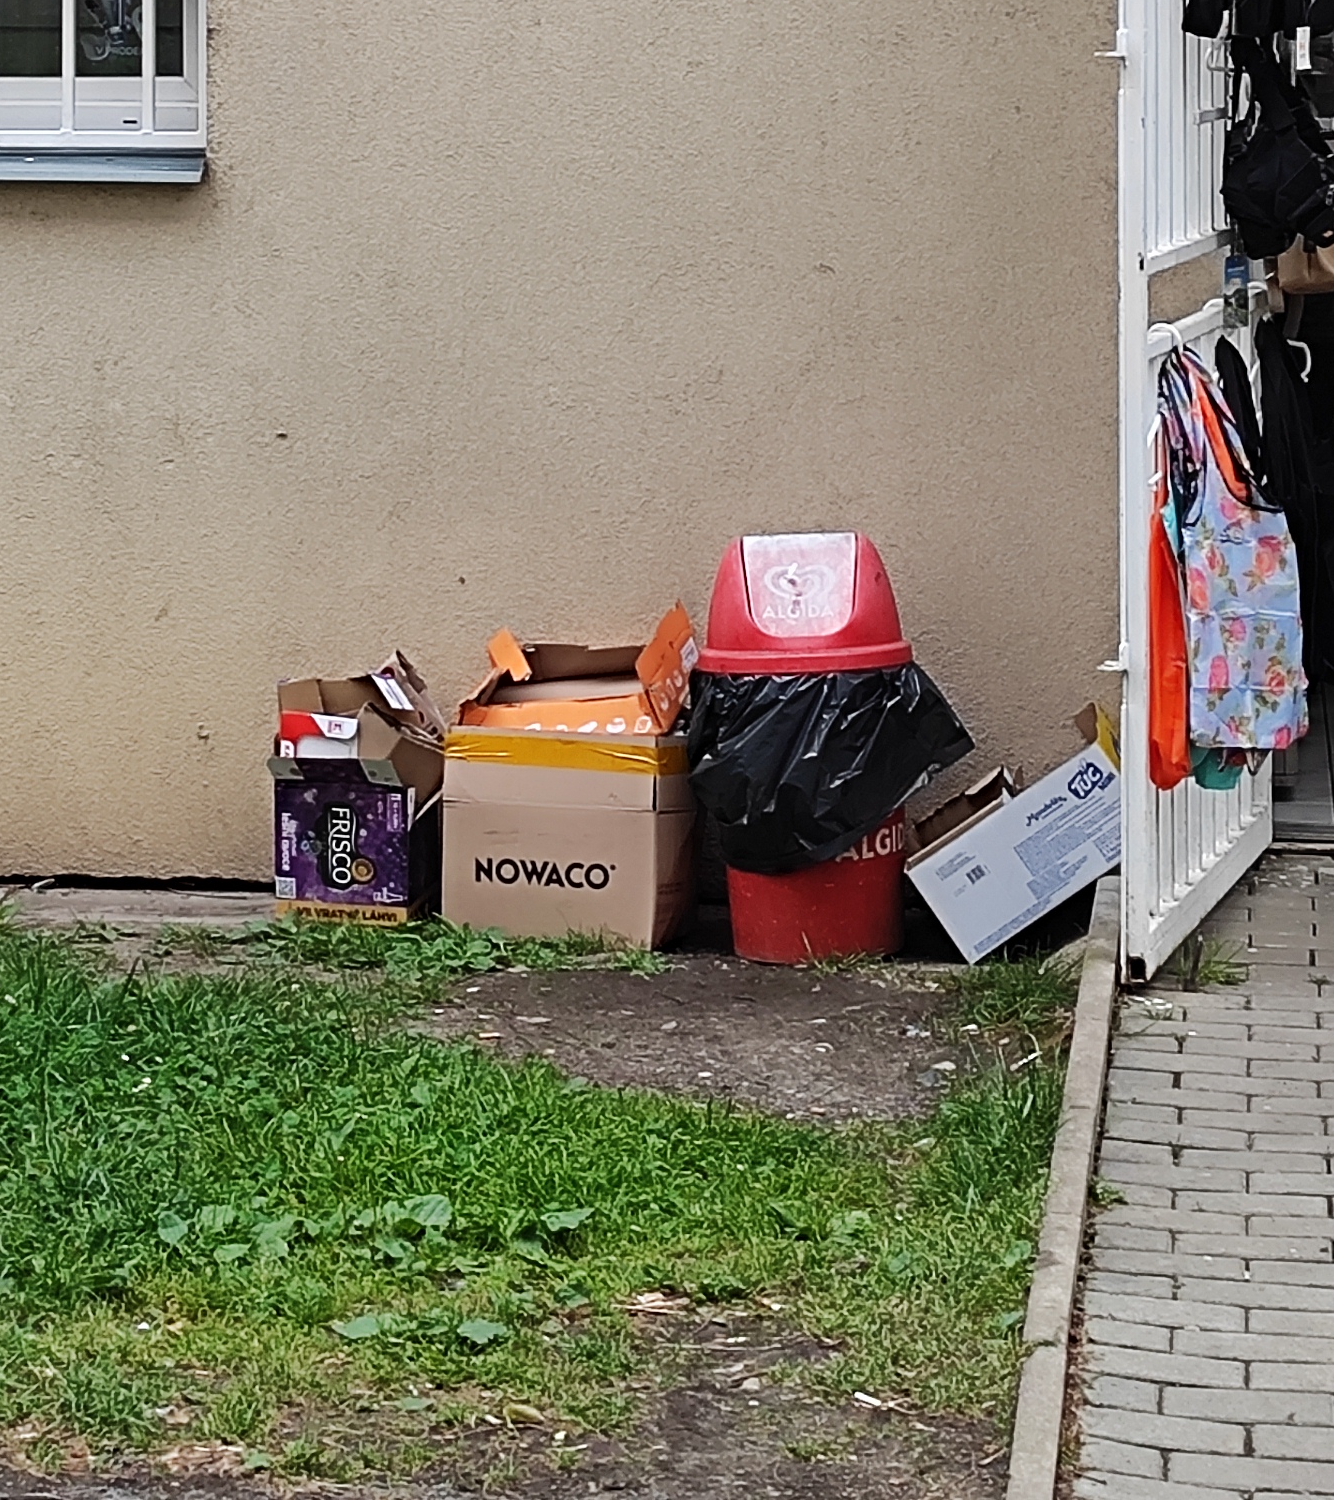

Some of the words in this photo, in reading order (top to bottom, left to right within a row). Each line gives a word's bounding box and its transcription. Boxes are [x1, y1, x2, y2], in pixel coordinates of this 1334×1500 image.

[762, 604, 835, 619] ALGIDA
[1070, 766, 1101, 797] TUC
[329, 807, 351, 884] FRISCO
[474, 857, 611, 890] NOWACO
